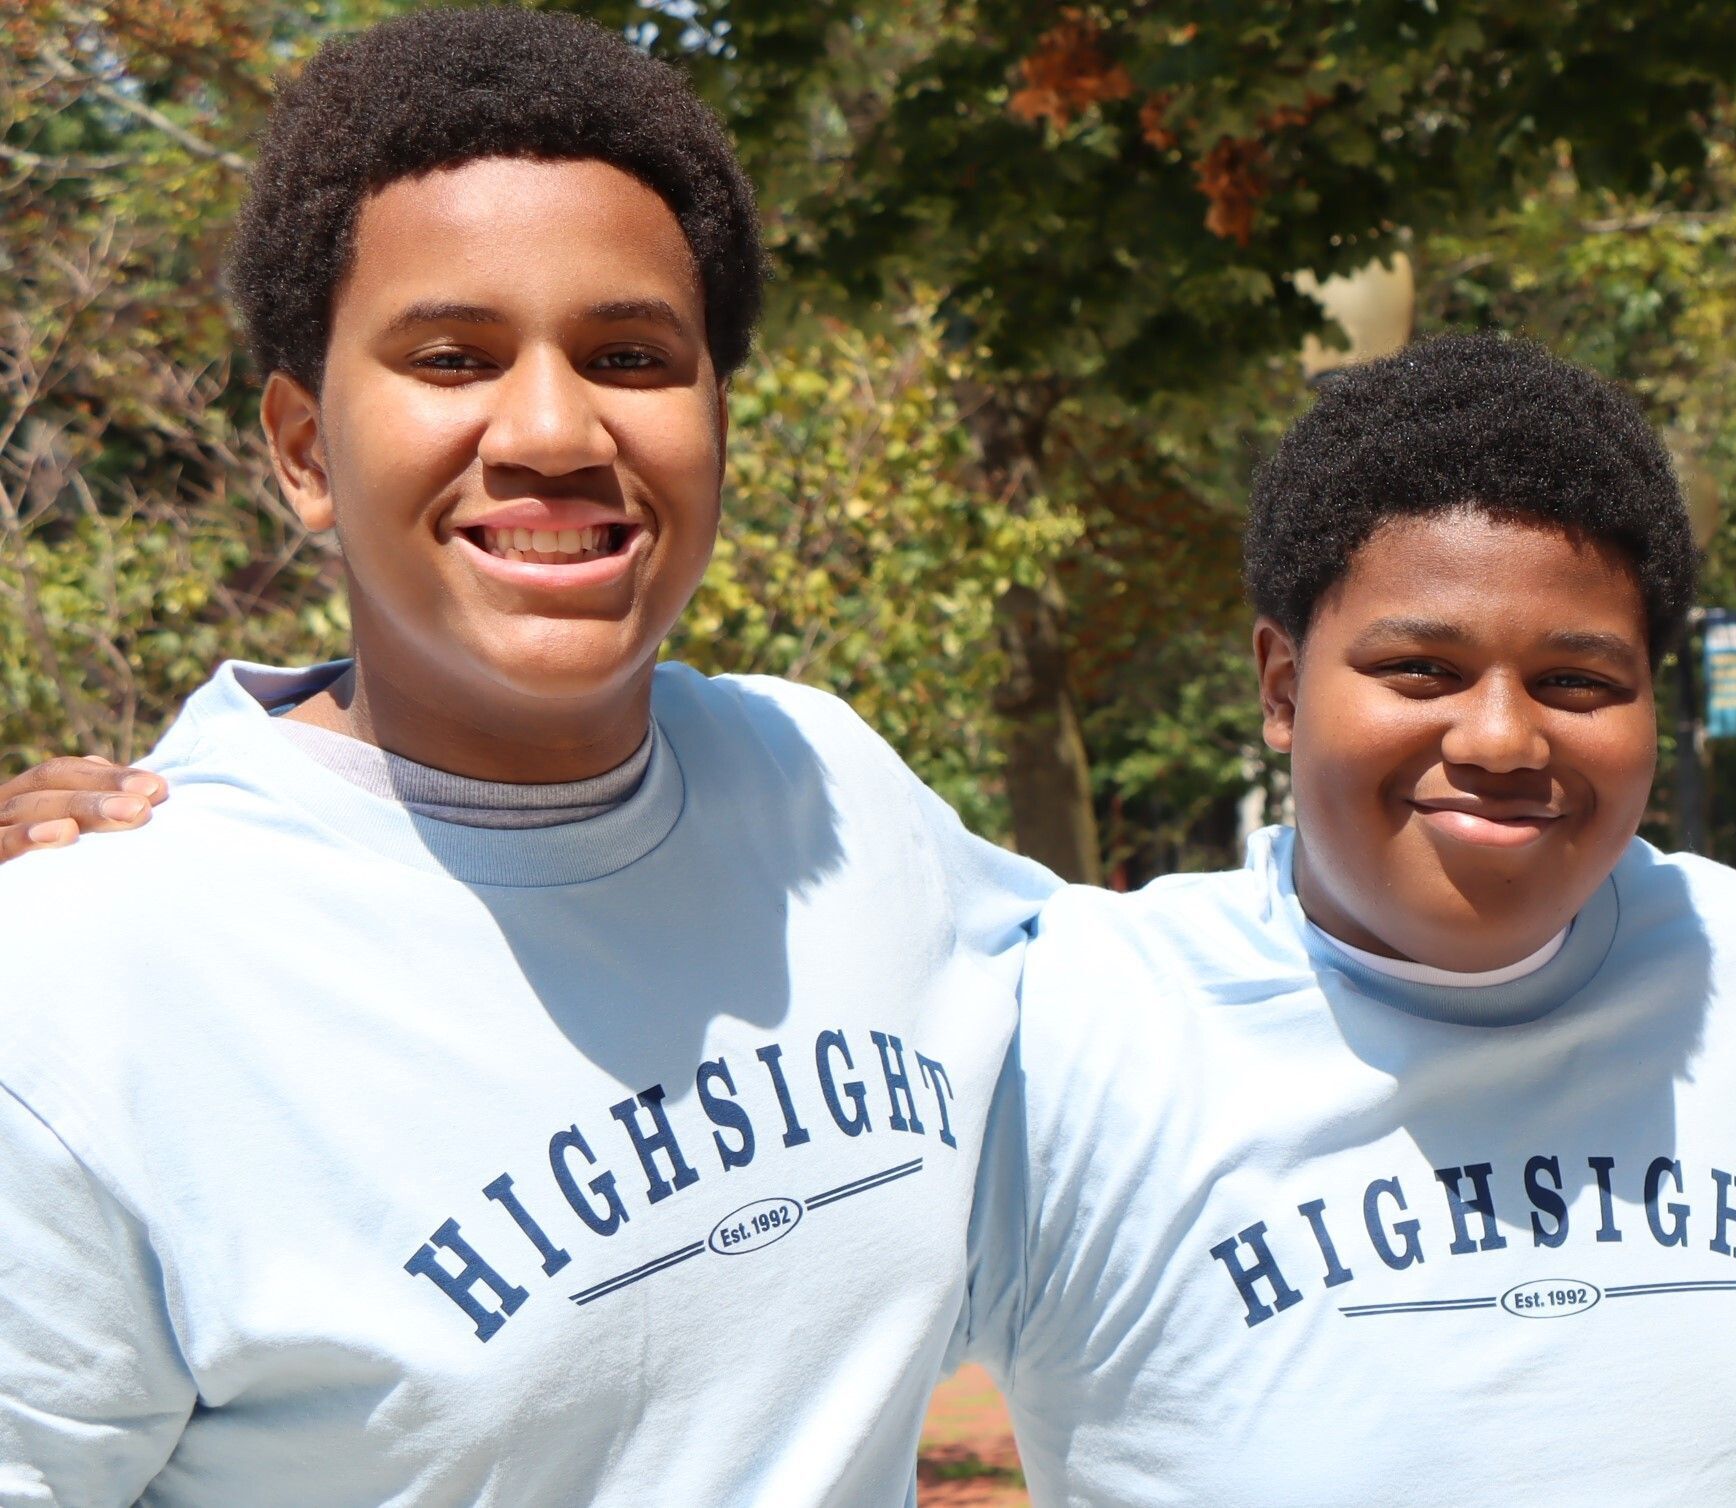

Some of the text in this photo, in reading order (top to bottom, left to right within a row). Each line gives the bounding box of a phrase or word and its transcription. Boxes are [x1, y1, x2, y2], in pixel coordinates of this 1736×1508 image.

[403, 1029, 957, 1343] HIGHSIGHT
[720, 1206, 791, 1248] Est. 1992
[1514, 1288, 1587, 1309] Est. 1992
